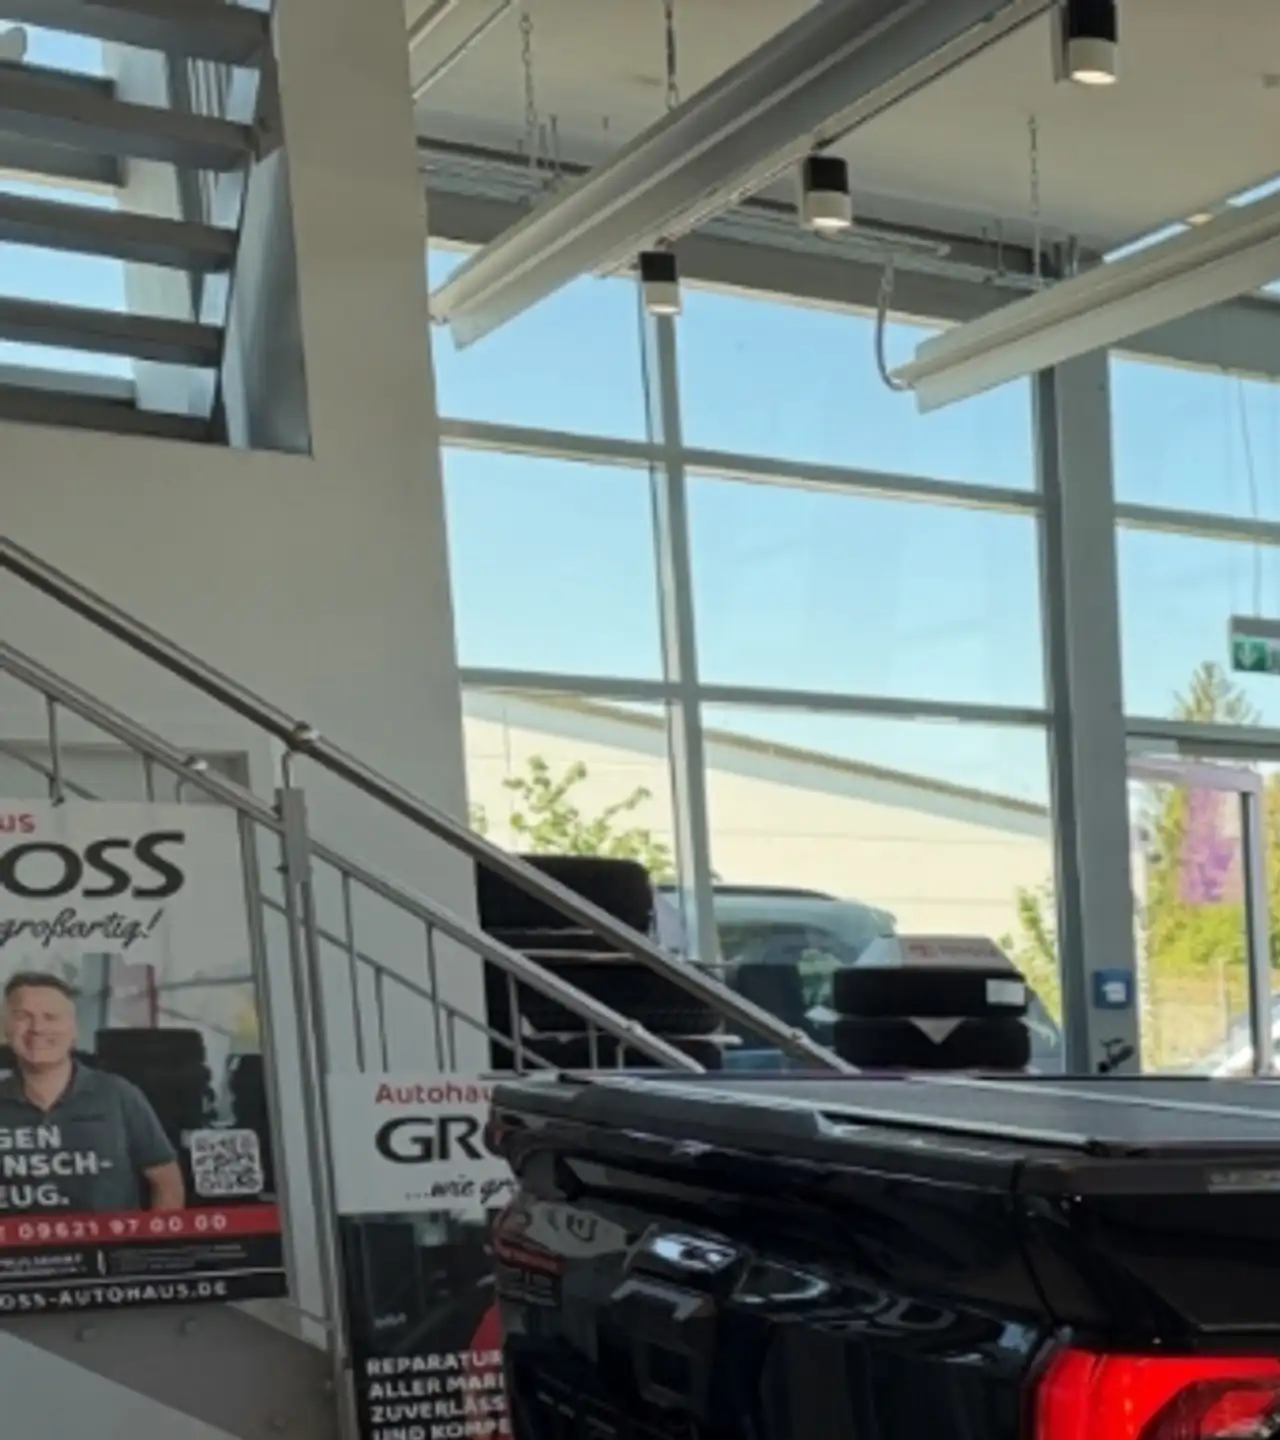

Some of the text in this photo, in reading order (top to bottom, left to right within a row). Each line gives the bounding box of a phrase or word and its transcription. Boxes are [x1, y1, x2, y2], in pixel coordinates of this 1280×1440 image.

[108, 1217, 140, 1236] 97
[150, 1215, 183, 1233] 00
[195, 1213, 228, 1231] 00
[370, 1377, 441, 1400] ALLER
